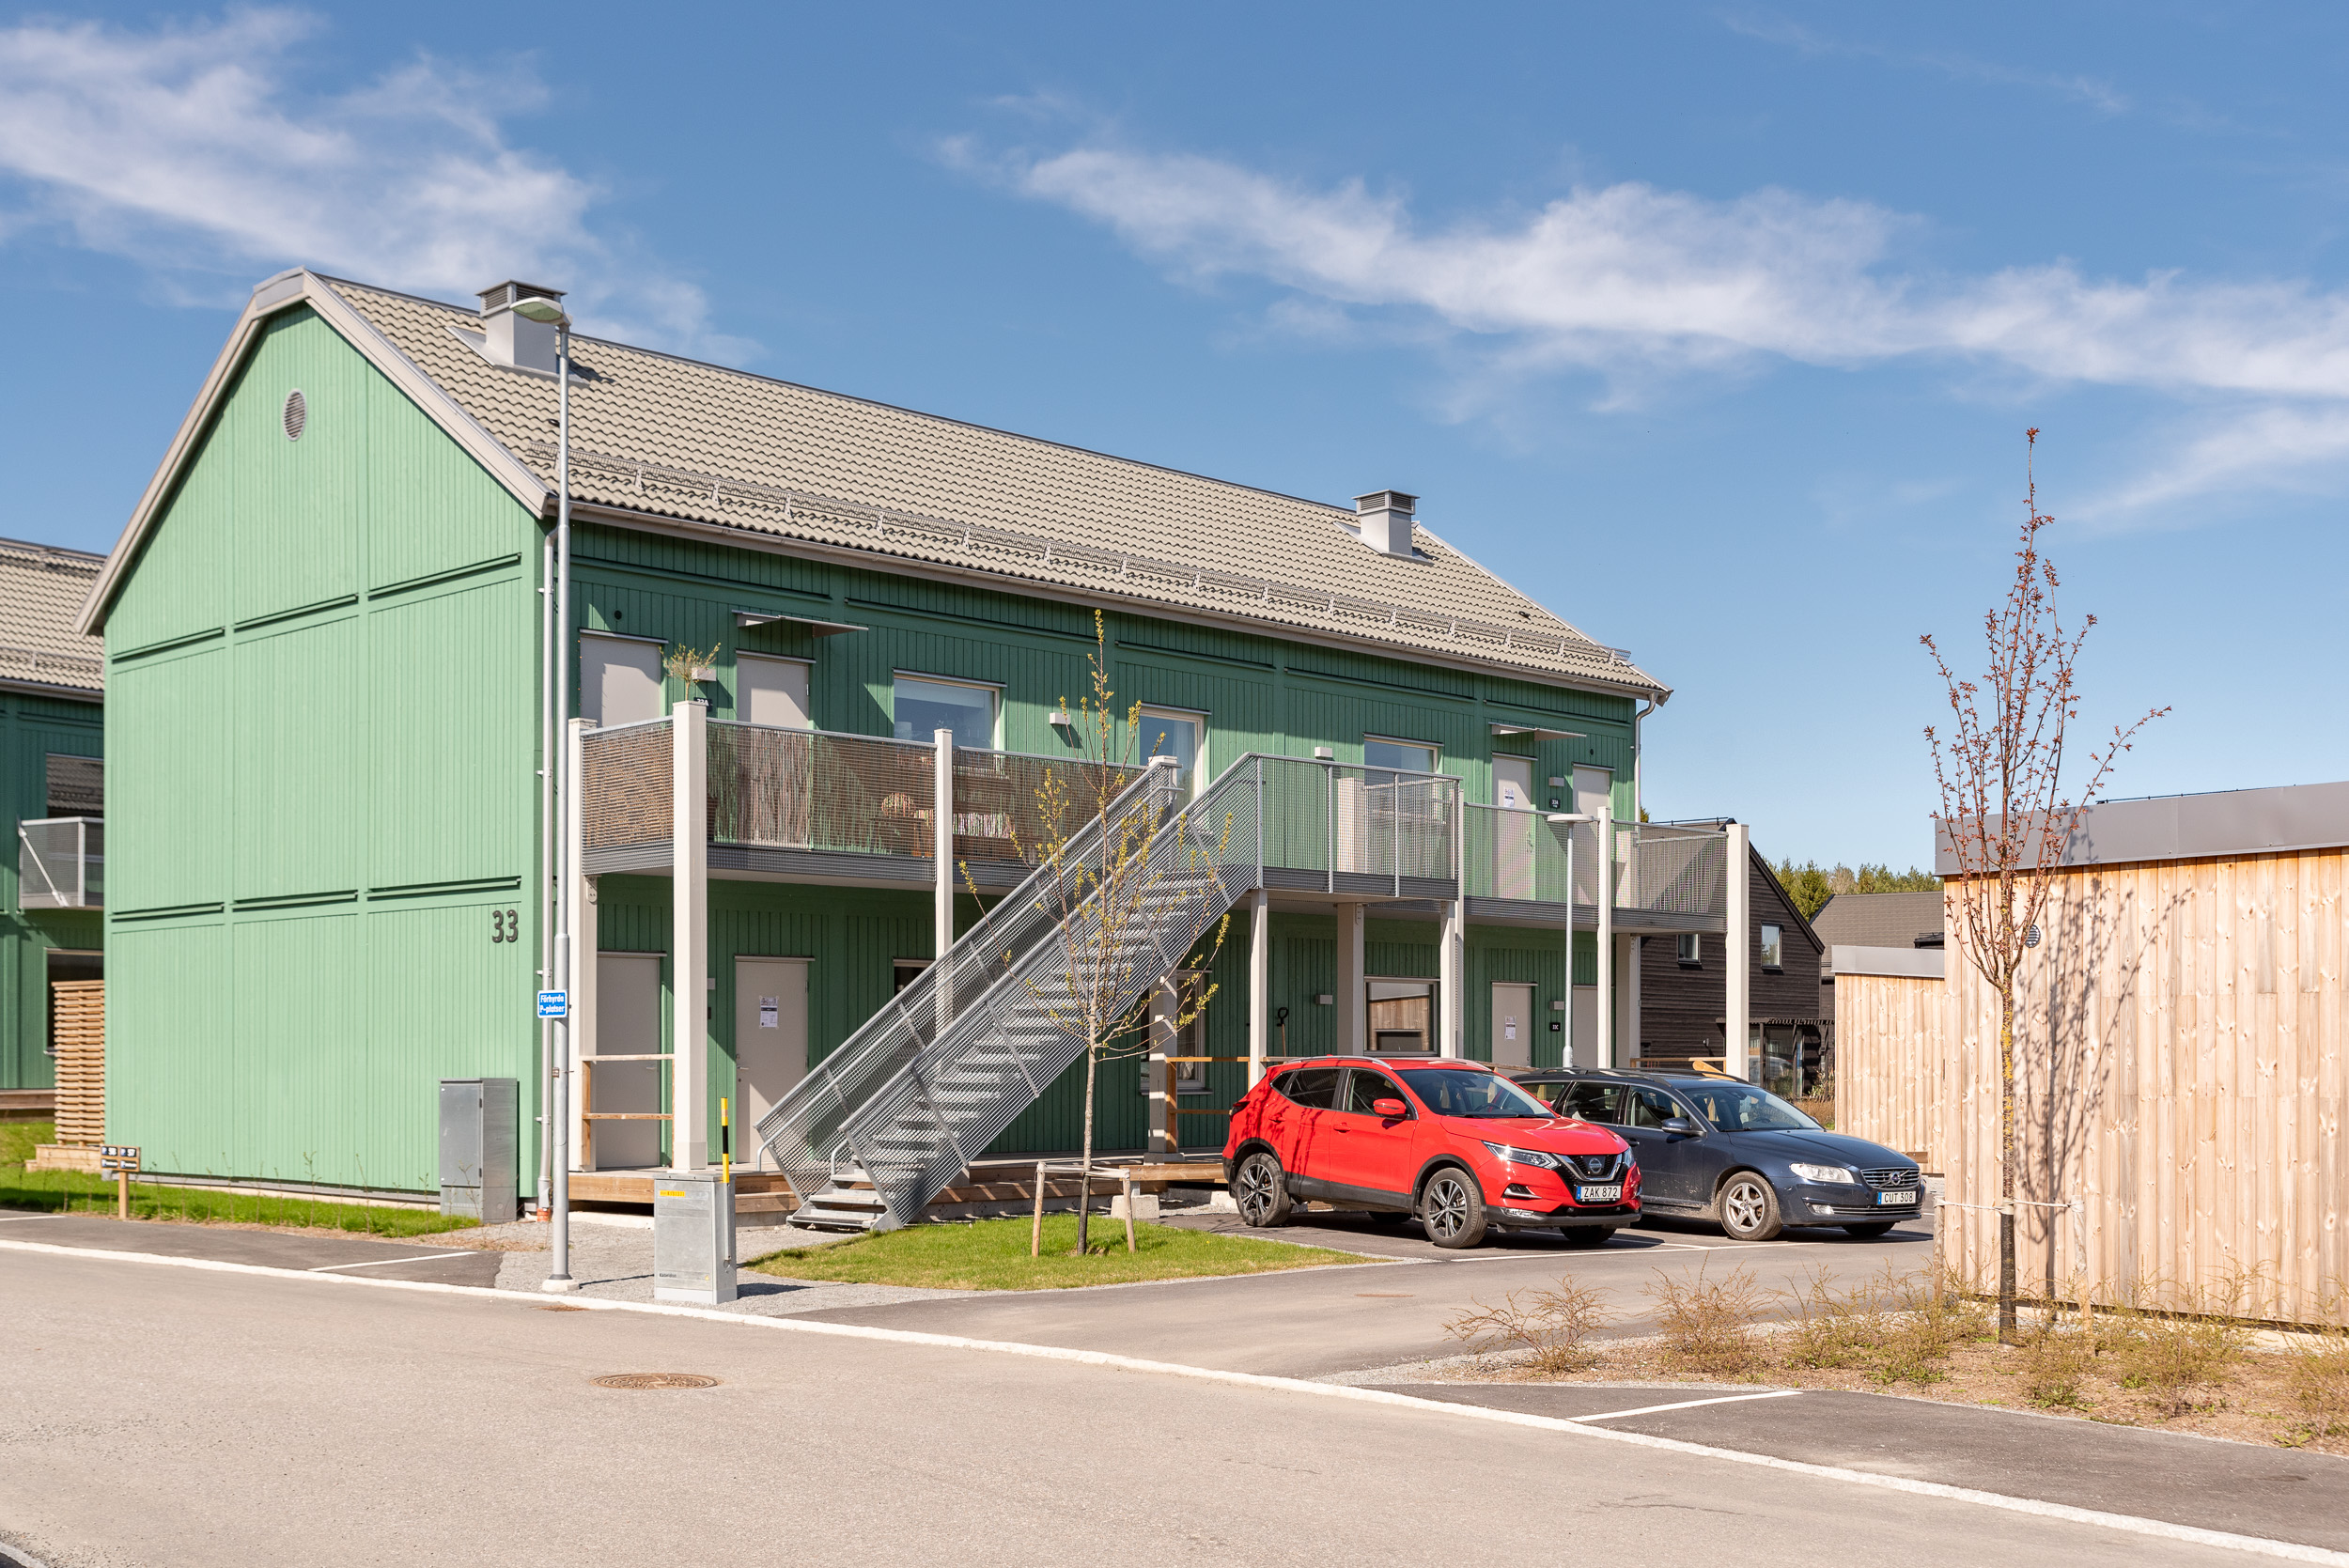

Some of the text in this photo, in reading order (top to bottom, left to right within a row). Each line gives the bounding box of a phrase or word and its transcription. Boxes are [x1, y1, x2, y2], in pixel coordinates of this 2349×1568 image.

[491, 909, 519, 943] 33
[540, 994, 564, 1003] Förhyrda
[539, 1004, 565, 1014] P-platser
[1584, 1188, 1618, 1198] ZAK 872
[1884, 1193, 1913, 1203] CUT 308
